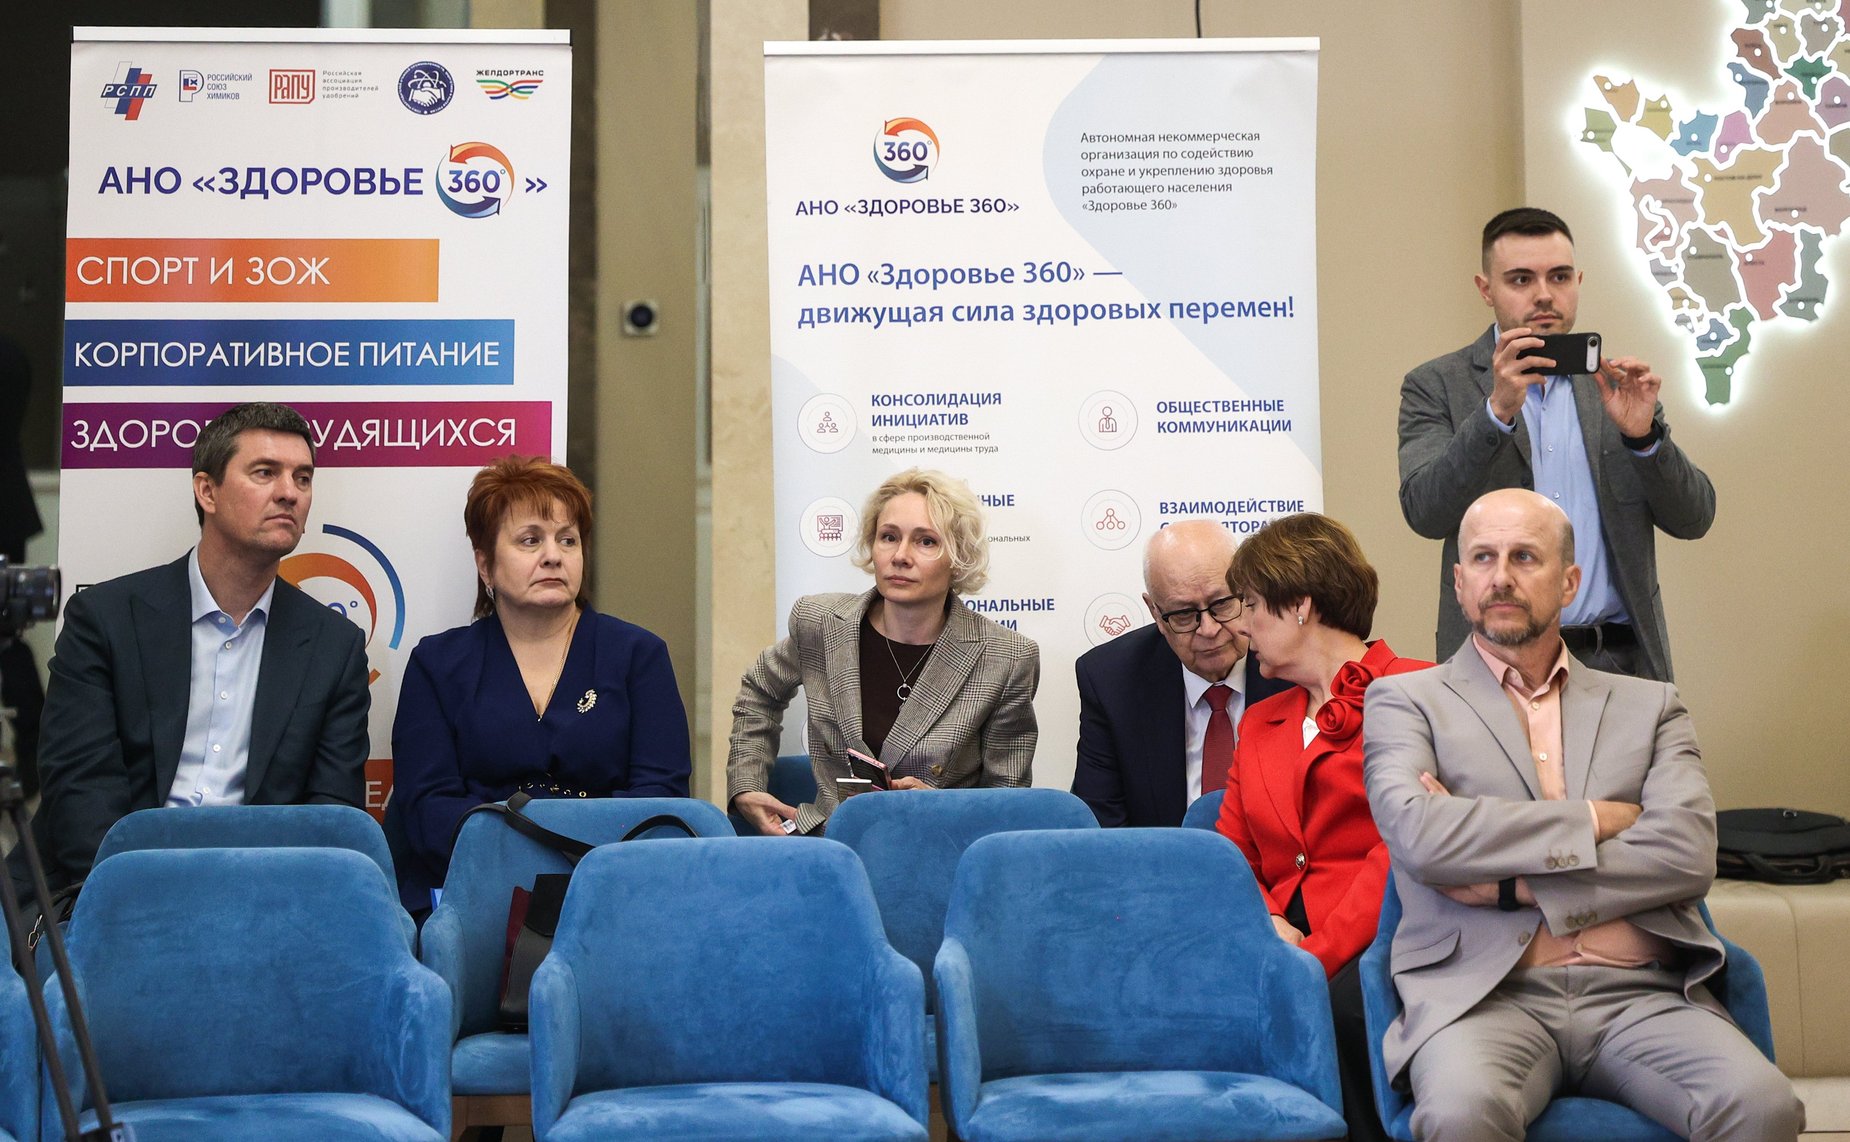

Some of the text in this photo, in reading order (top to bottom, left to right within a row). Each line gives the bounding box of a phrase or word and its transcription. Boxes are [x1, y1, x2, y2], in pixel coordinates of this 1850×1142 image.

[206, 72, 253, 82] РОССИЙСКИЙ
[475, 69, 544, 78] ЖЕЛДОРТРАНС
[102, 85, 155, 97] РСПП
[206, 82, 228, 91] СОЮЗ
[206, 92, 240, 101] ХИМИКОВ
[1080, 132, 1261, 144] Автономная некоммерческая
[1080, 147, 1254, 163] организация по содействию
[1081, 166, 1274, 179] охране и укреплению здоровья
[97, 166, 182, 195] АНО
[192, 166, 424, 200] «ЗДОРОВЬЕ
[1081, 182, 1233, 197] работающего населения
[795, 198, 1020, 217] АНО «ЗДОРОВЬЕ 360»
[1082, 199, 1178, 214] «Здоровье 360»
[77, 256, 331, 286] СПОРТ И ЗОЖ
[797, 262, 860, 287] АНО
[867, 262, 1015, 291] «Здоровье
[1023, 261, 1085, 284] 360»
[797, 295, 1294, 330] движущая сила здоровых перемен!
[75, 341, 500, 367] КОРПОРАТИВНОЕ ПИТАНИЕ
[871, 392, 1002, 409] КОНСОЛИДАЦИЯ
[1156, 399, 1285, 416] ОБЩЕСТВЕННЫЕ
[871, 412, 969, 429] ИНИЦИАТИВ
[1157, 419, 1292, 435] КОММУНИКАЦИИ
[71, 418, 516, 452] ЗДОРО УДЯЩИХСЯ
[871, 432, 990, 444] в сфере производственной
[871, 445, 999, 456] медицины и медицины труда
[1159, 498, 1304, 516] ВЗАИМОДЕЙСТВИЕ
[987, 535, 1031, 543] ональных
[965, 598, 1055, 612] ОНАЛЬНЫЕ
